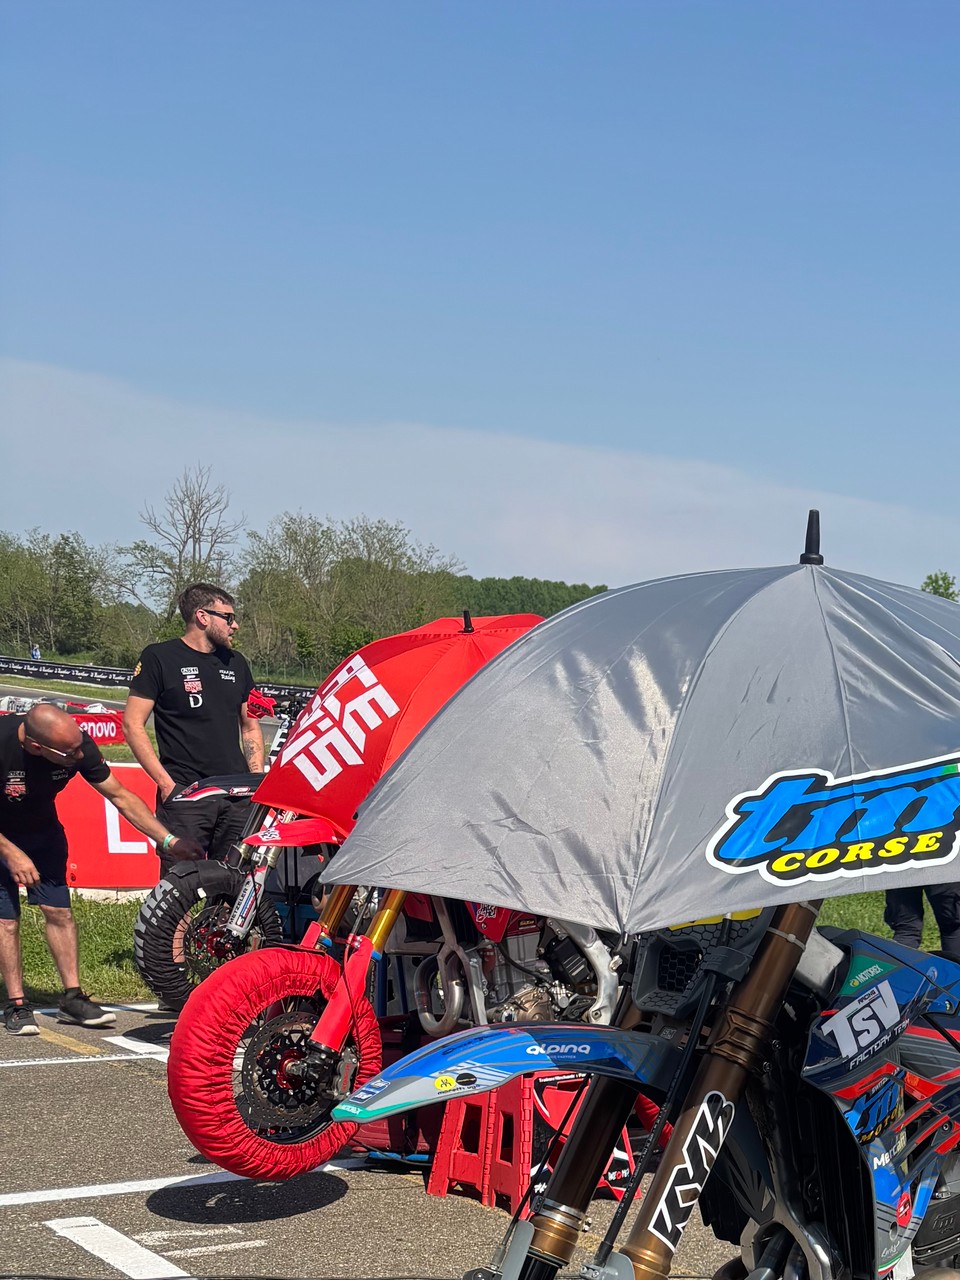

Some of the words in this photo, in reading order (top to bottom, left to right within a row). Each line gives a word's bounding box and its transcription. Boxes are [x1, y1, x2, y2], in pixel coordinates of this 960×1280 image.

[80, 721, 117, 737] enovo
[771, 832, 943, 873] CORSE
[151, 889, 180, 926] PARTS
[228, 887, 249, 925] METZELER
[857, 964, 884, 984] MOTOREX
[821, 979, 900, 1060] TSV
[526, 1043, 591, 1055] alpina
[849, 1033, 892, 1070] FACTORY
[648, 1090, 735, 1254] KYB
